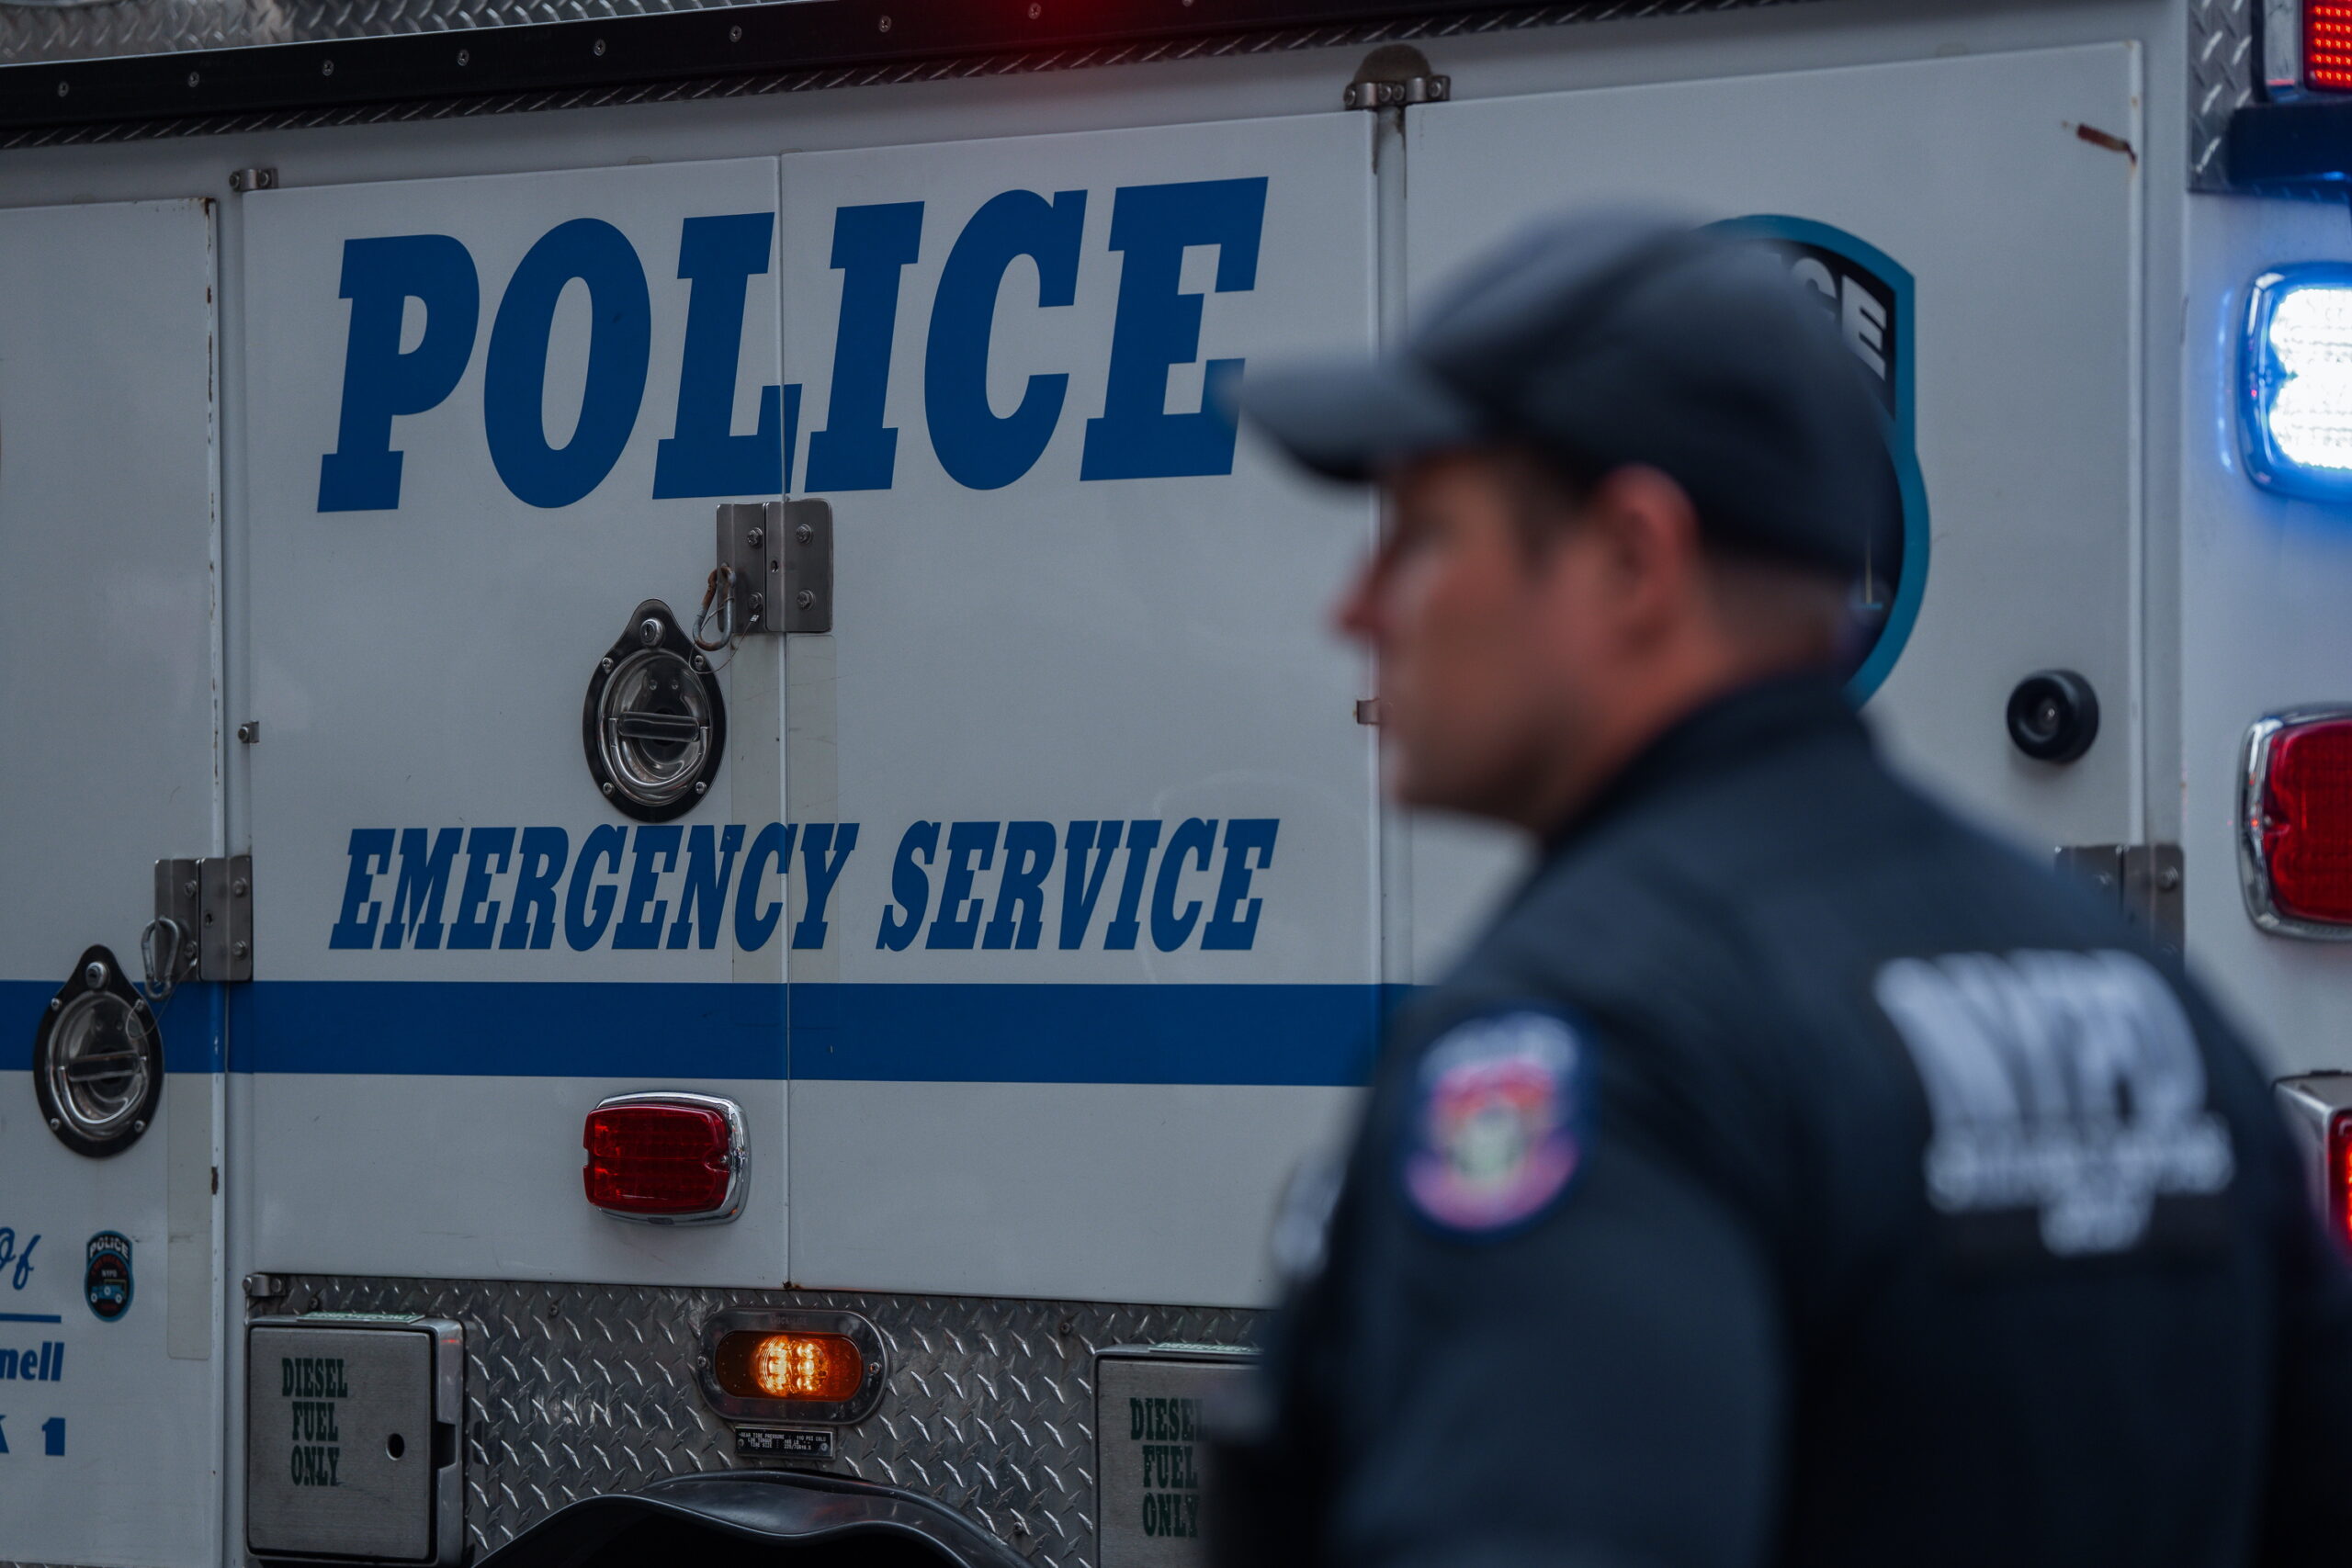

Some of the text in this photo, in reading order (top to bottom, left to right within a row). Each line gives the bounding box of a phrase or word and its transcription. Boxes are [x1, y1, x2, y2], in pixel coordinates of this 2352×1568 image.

[318, 176, 1268, 513] POLICE
[329, 817, 1280, 953] EMERGENCY SERVICE
[89, 1235, 130, 1259] POLICE
[282, 1357, 348, 1398] DIESEL
[41, 1417, 66, 1457] 1
[292, 1401, 339, 1442] FUEL
[290, 1444, 341, 1487] ONLY
[1142, 1445, 1199, 1489] FUEL
[1142, 1492, 1199, 1538] ONLY
